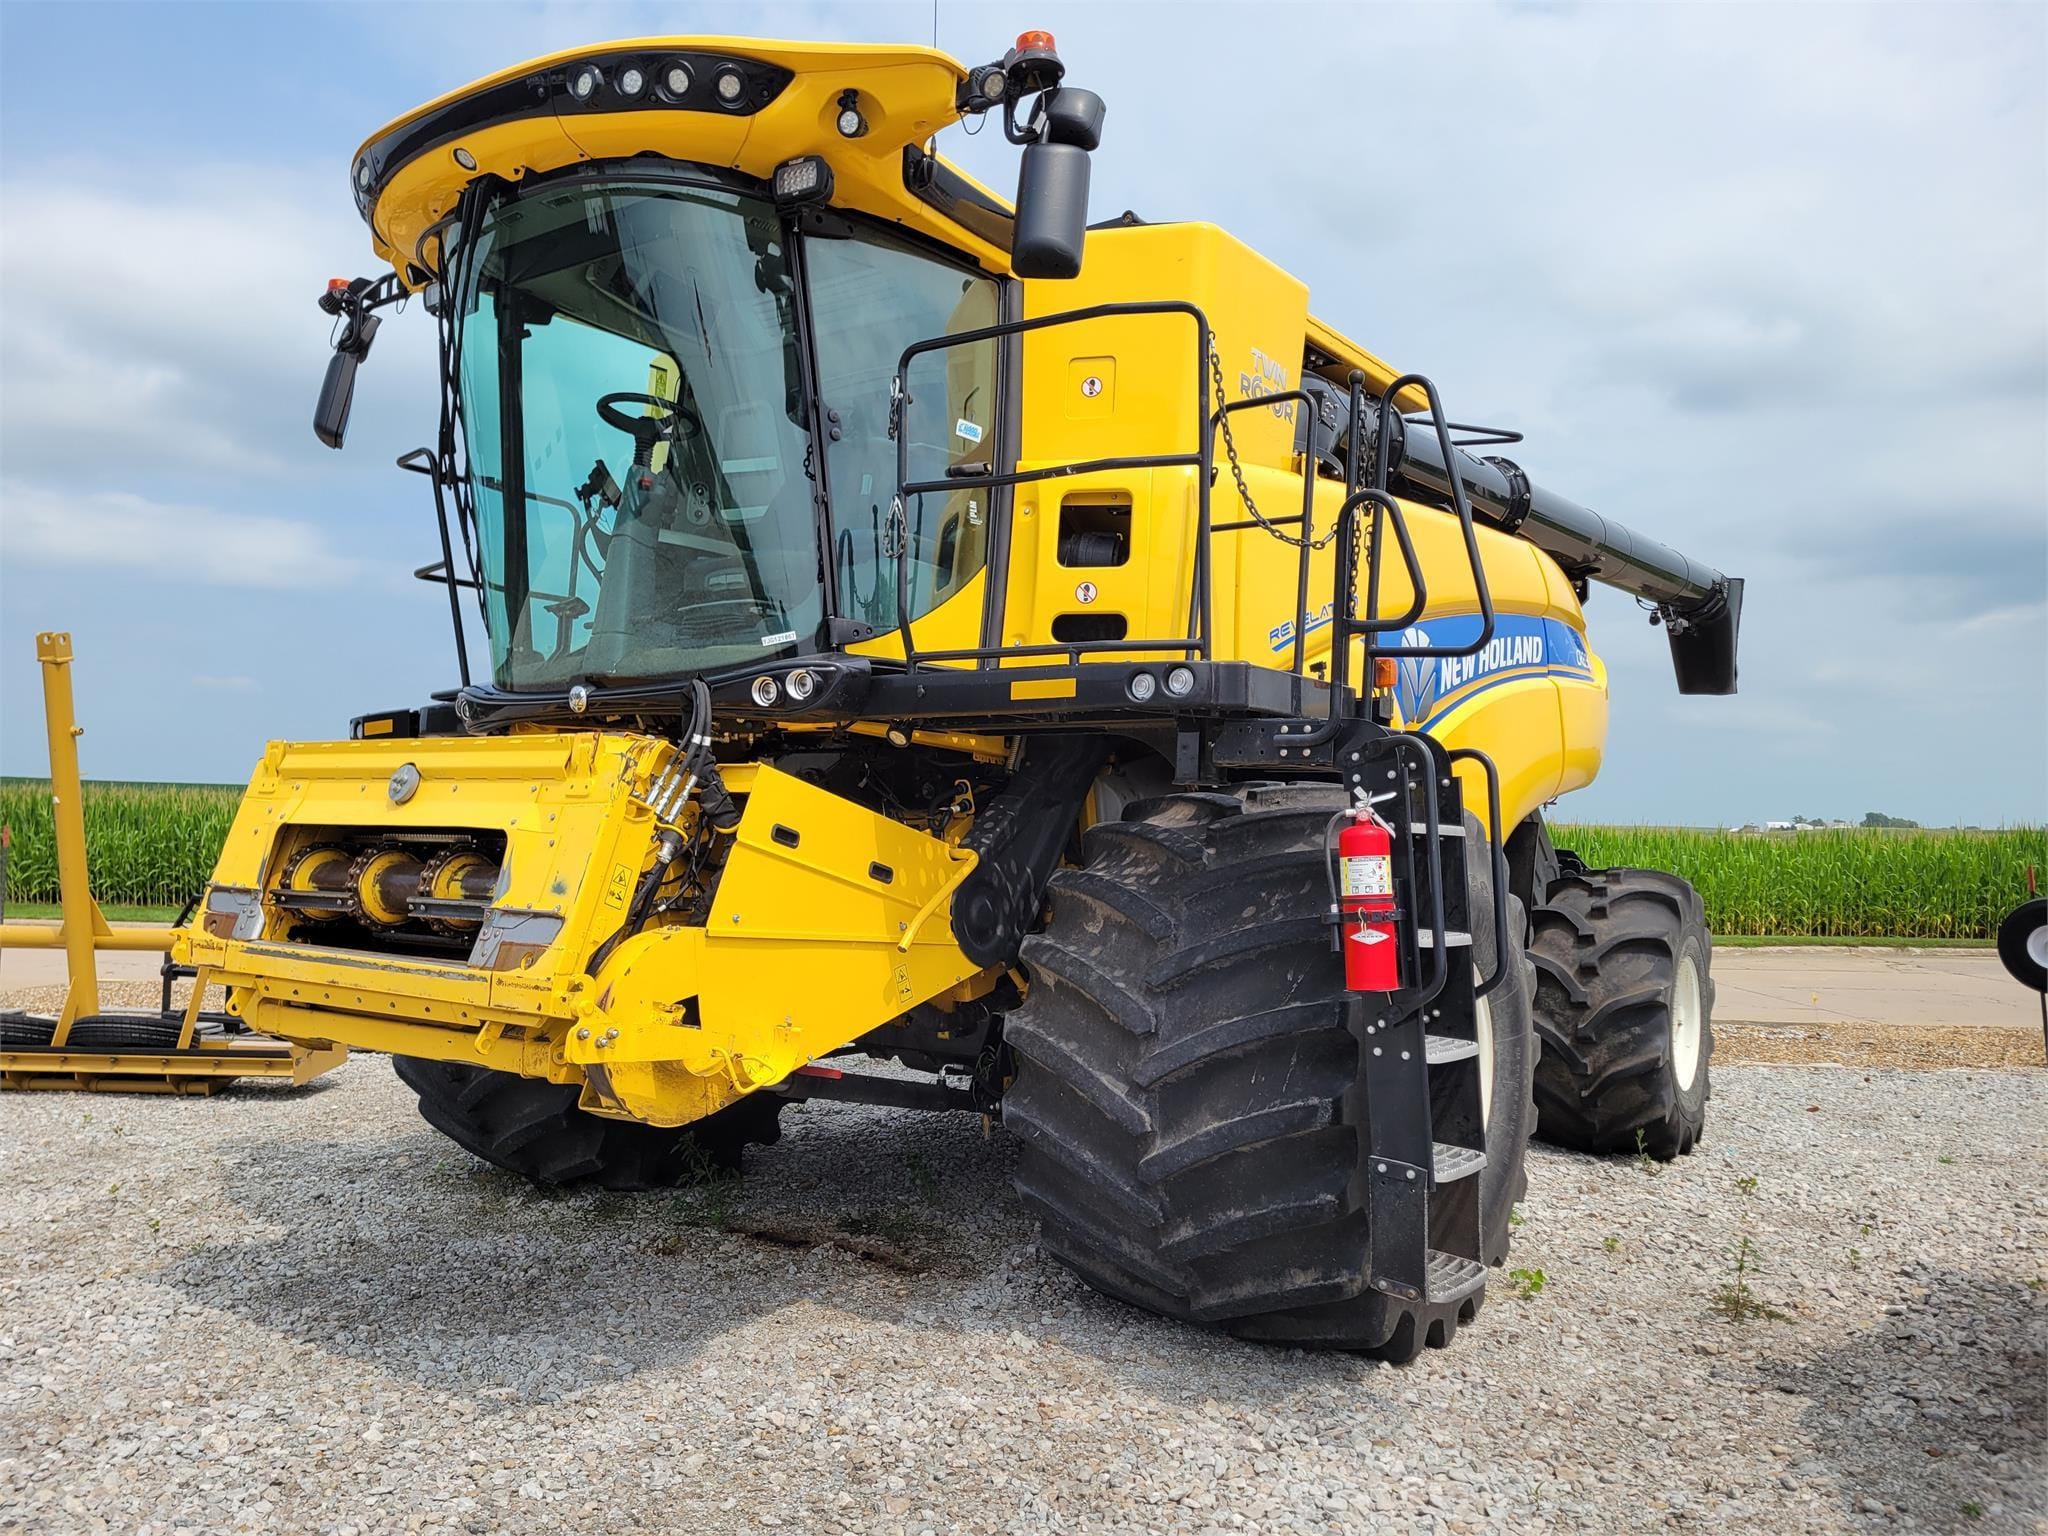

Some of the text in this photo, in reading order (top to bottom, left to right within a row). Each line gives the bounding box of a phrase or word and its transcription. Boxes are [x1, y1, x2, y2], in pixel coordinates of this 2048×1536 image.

[1250, 347, 1288, 391] TWIN
[1440, 653, 1476, 694] NEW
[1478, 636, 1543, 674] HOLLAND
